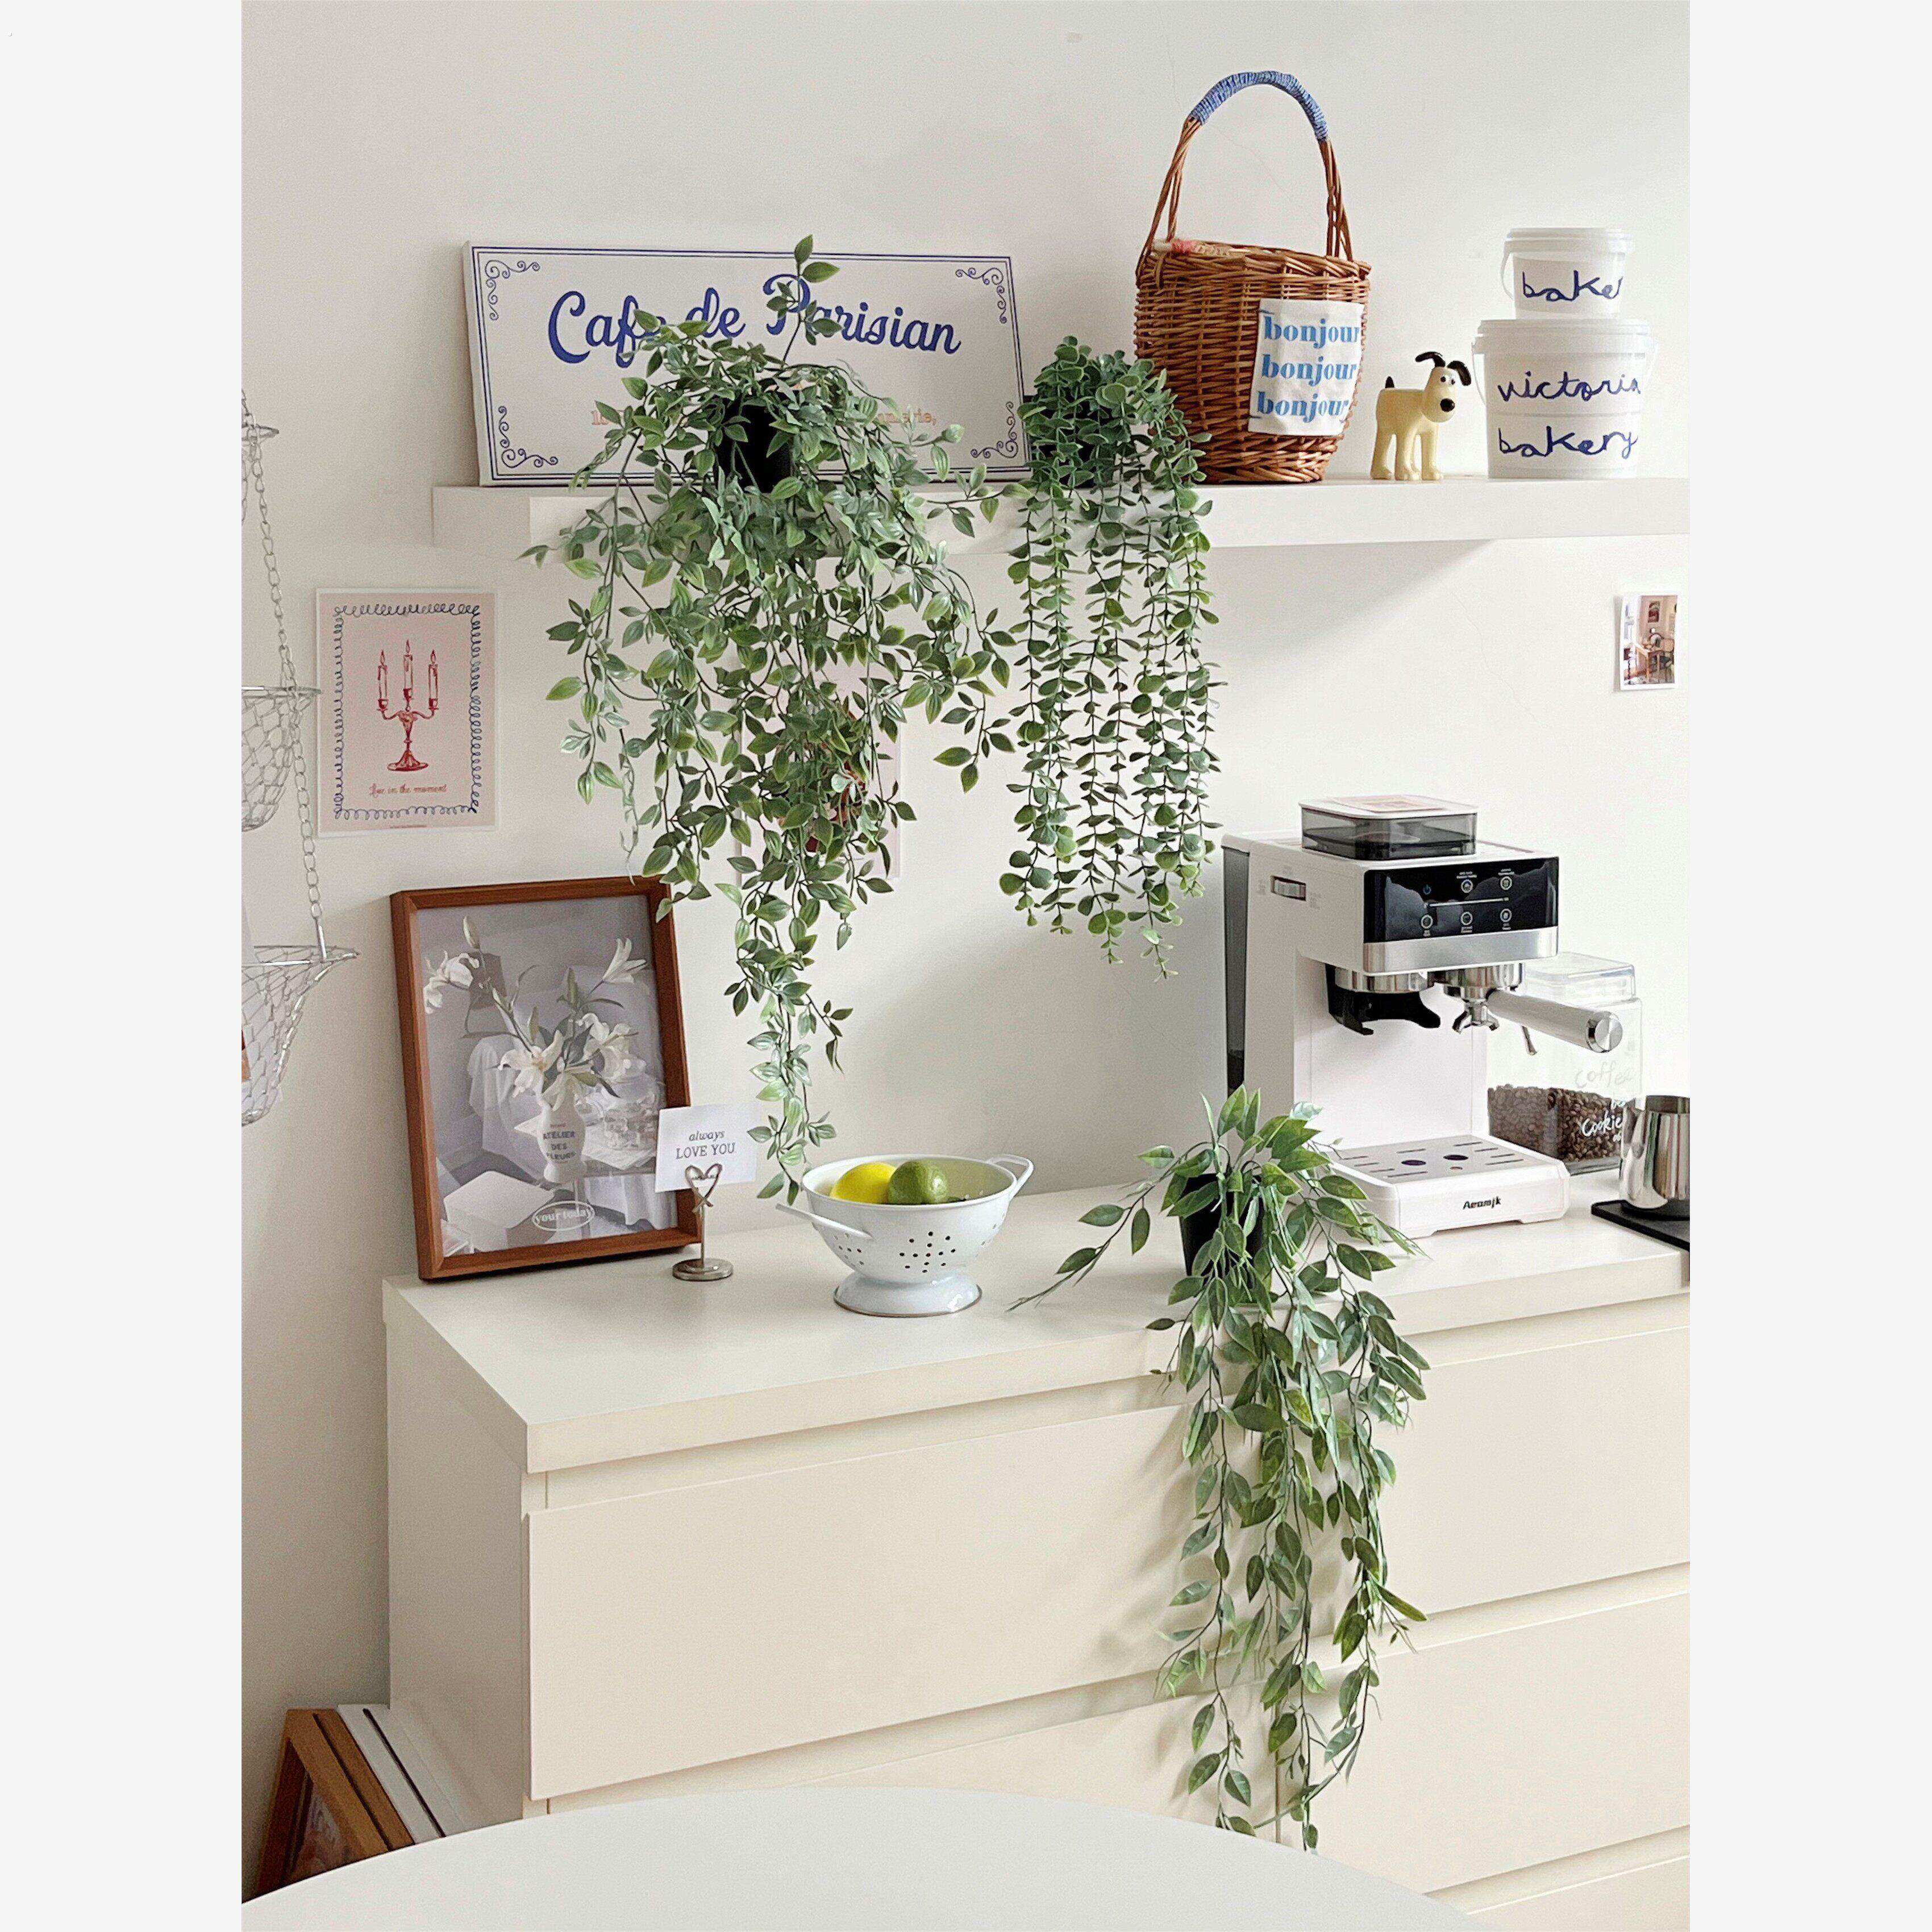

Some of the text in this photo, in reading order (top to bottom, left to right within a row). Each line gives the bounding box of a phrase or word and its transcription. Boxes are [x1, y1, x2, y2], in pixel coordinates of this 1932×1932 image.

[685, 287, 746, 338] de
[1264, 315, 1360, 349] bonjour
[1261, 353, 1357, 386] bonjour
[1257, 391, 1350, 423] bonjour
[1498, 425, 1638, 459] bakery
[676, 1142, 736, 1159] LOVE YOU
[689, 1130, 725, 1142] always
